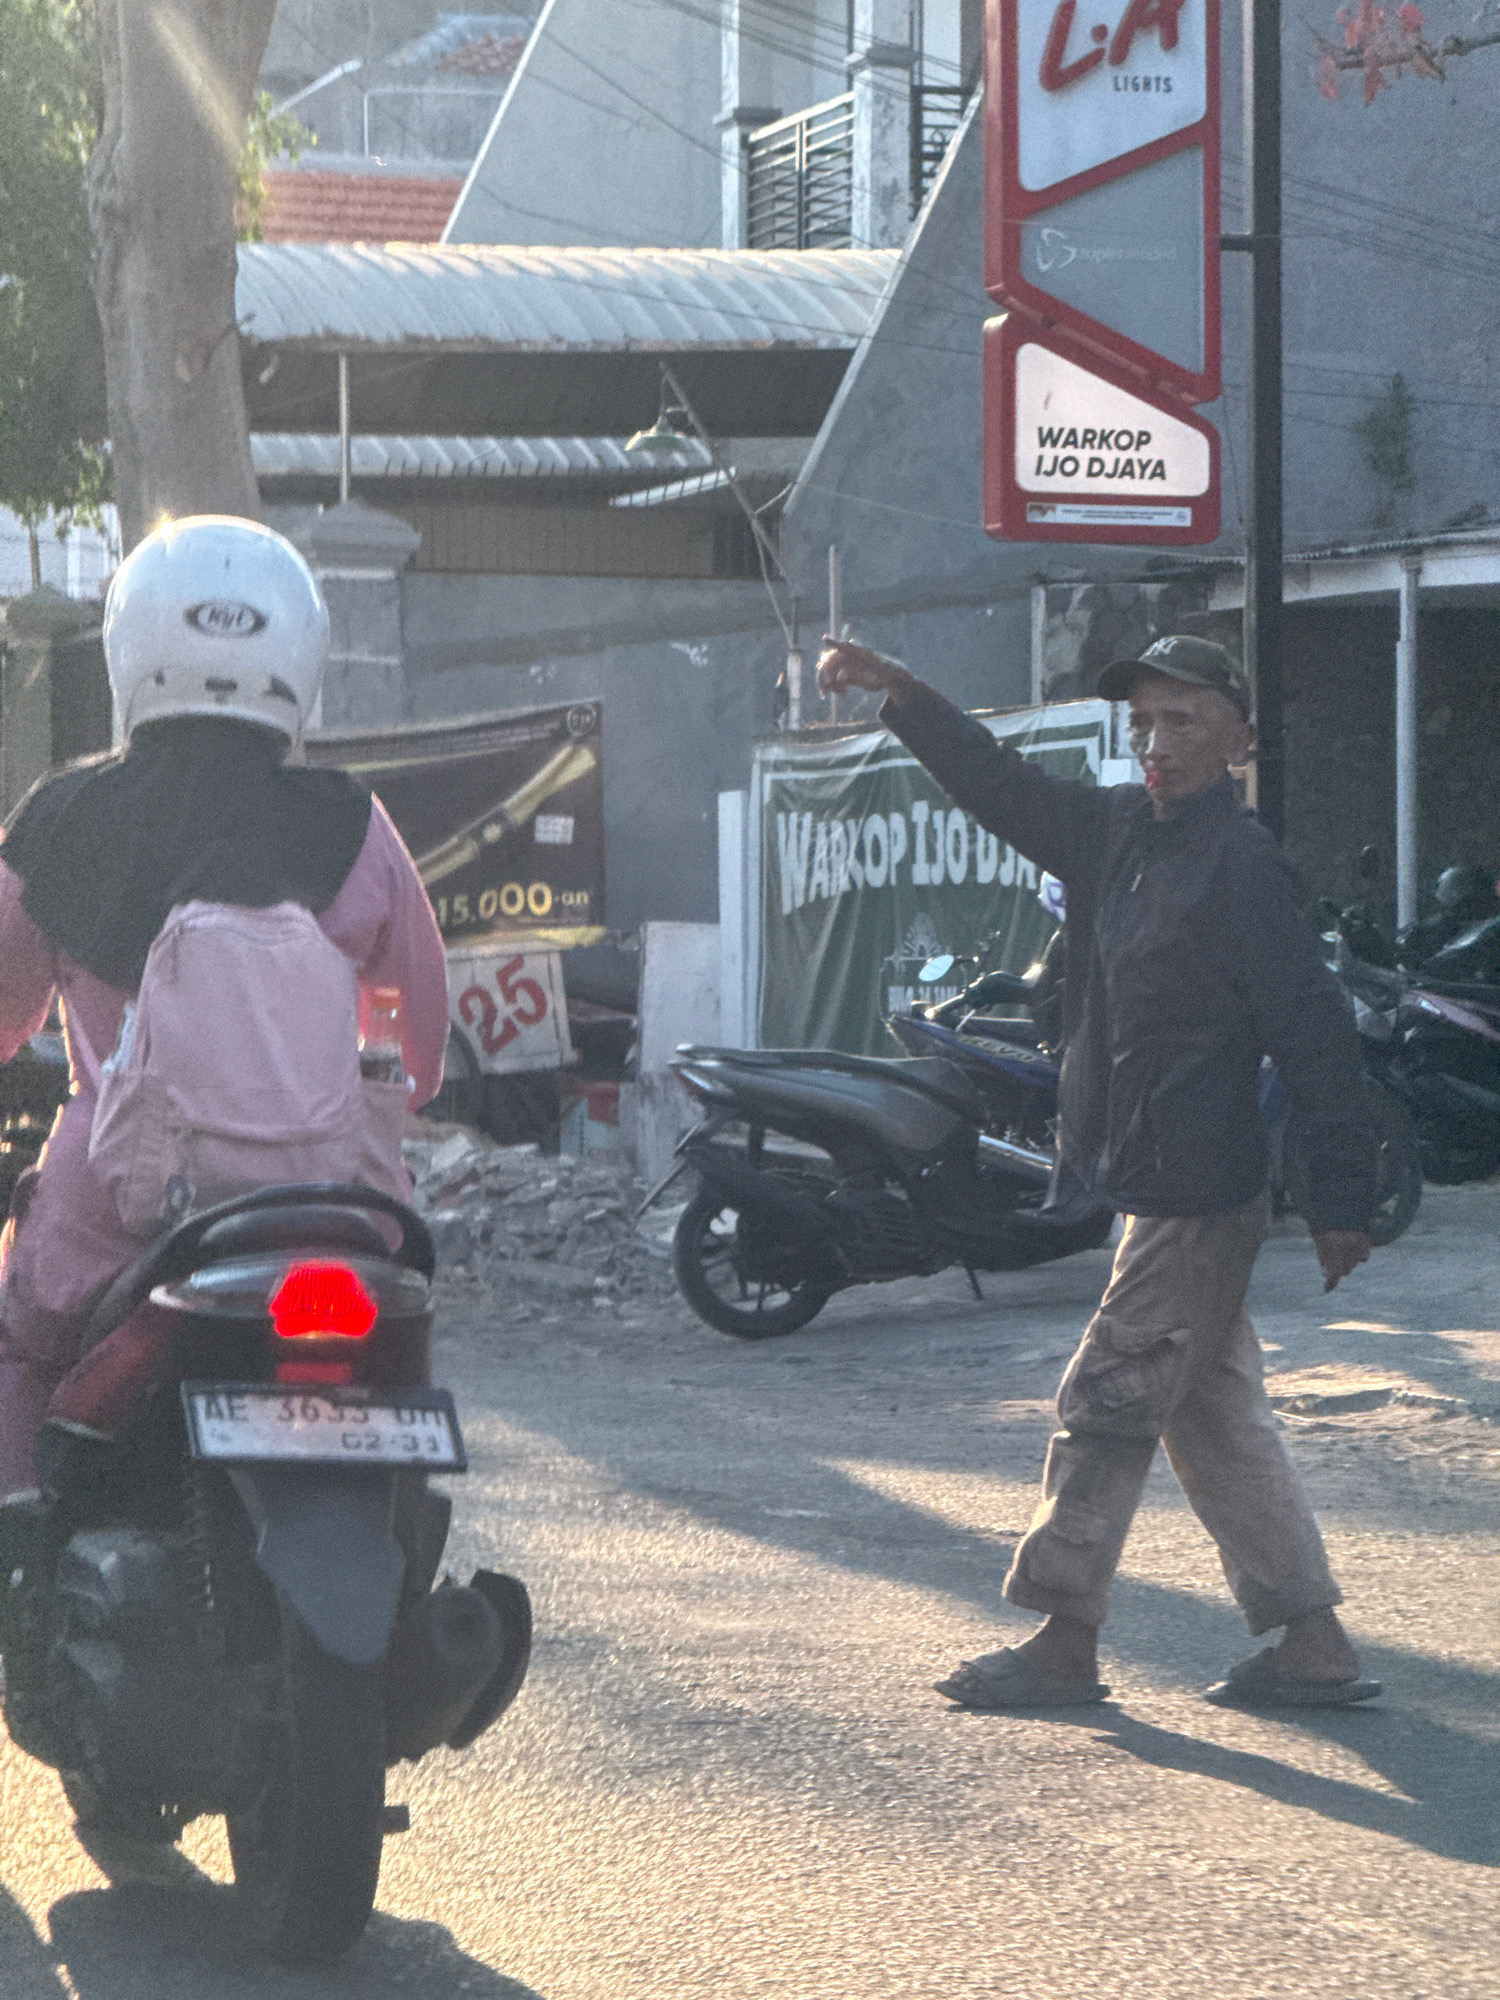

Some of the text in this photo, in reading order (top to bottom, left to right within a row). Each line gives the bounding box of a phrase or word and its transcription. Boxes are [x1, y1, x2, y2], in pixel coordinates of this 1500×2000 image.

[1112, 75, 1173, 94] LIGHTS
[1037, 426, 1152, 451] WARKOP
[1034, 454, 1167, 481] IJO DJAYA
[776, 811, 907, 916] WARKOP
[911, 800, 968, 886] IJO
[458, 954, 549, 1056] 25
